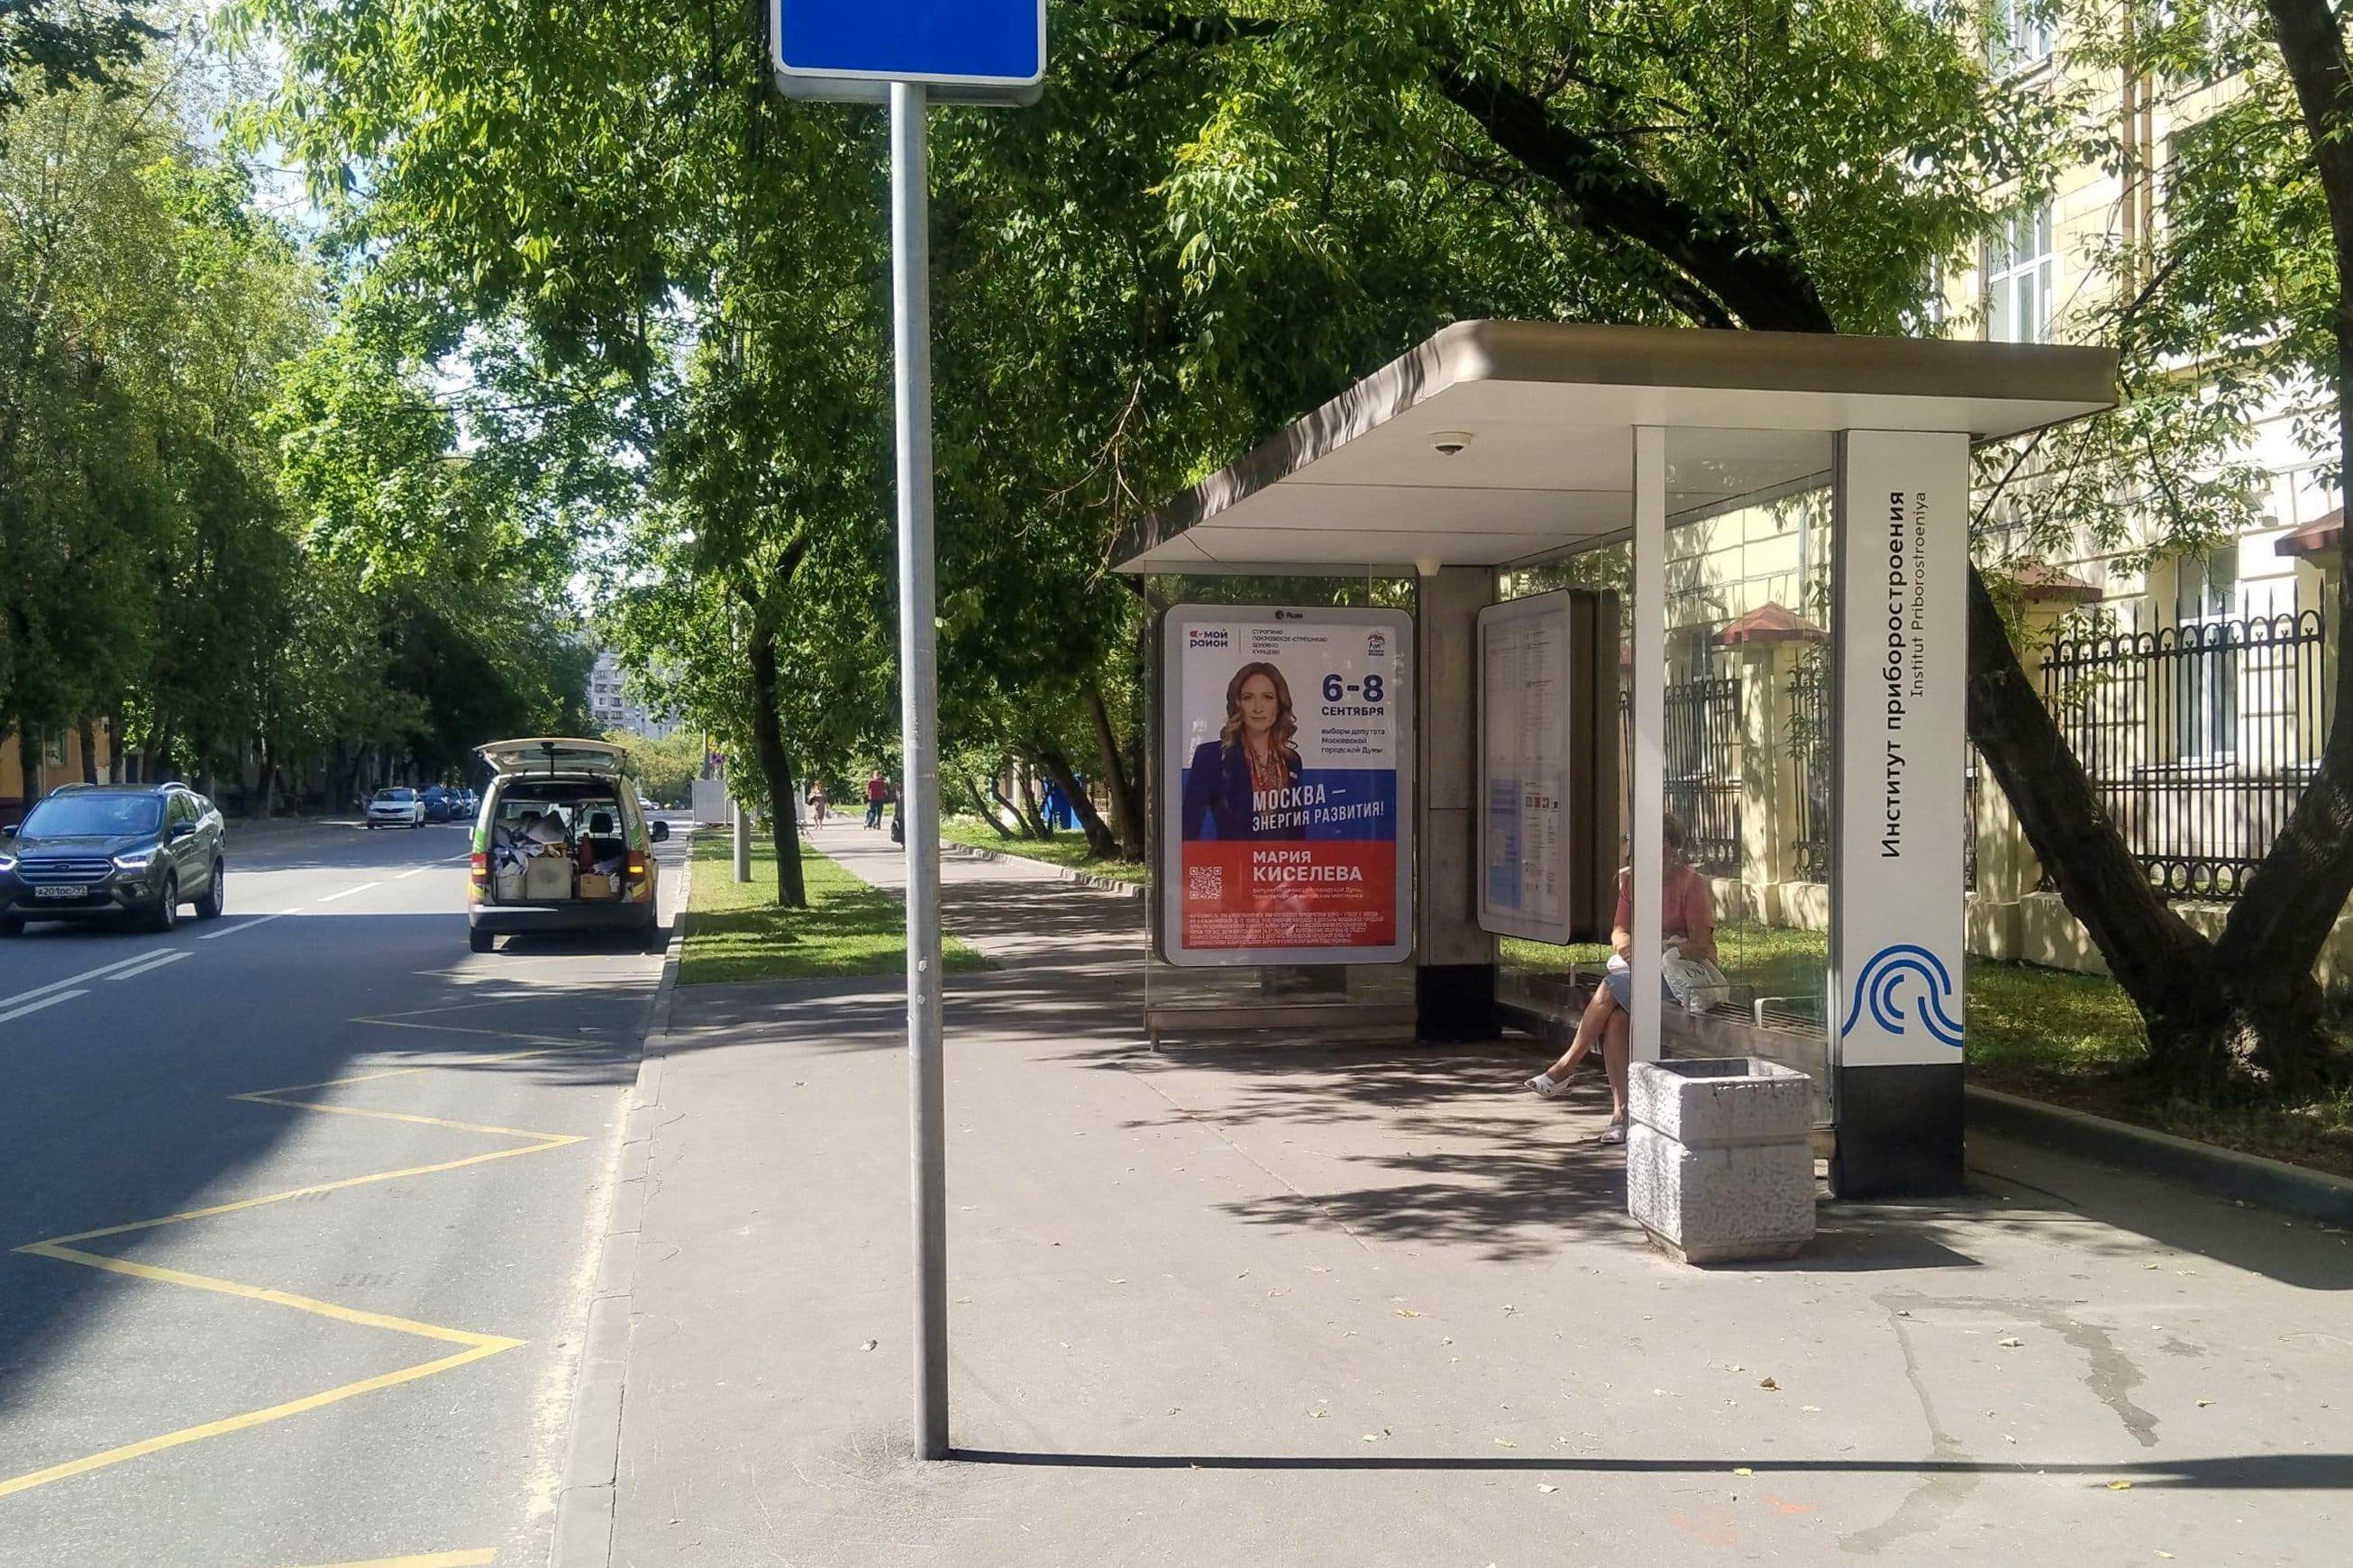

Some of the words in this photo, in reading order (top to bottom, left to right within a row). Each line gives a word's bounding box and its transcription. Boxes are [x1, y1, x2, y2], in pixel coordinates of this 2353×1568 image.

[1911, 492, 1929, 630] Priborostroeniya
[1883, 492, 1907, 730] приборостроения
[1204, 628, 1228, 639] мой
[1911, 637, 1924, 697] Institut
[1321, 707, 1384, 716] СЕНТЯБРЯ
[1352, 728, 1385, 736] депутата
[1321, 736, 1368, 744] Московской
[1321, 746, 1361, 754] городской
[1362, 746, 1382, 755] Думы
[1253, 783, 1327, 812] МОСКВА
[1882, 740, 1905, 857] Институт
[1253, 810, 1309, 832] ЭНЕРГИЯ
[1314, 800, 1384, 825] РАЗВИТИЯ!
[1253, 851, 1312, 863] МАРИЯ
[1253, 866, 1363, 881] КИСЕЛЕВА
